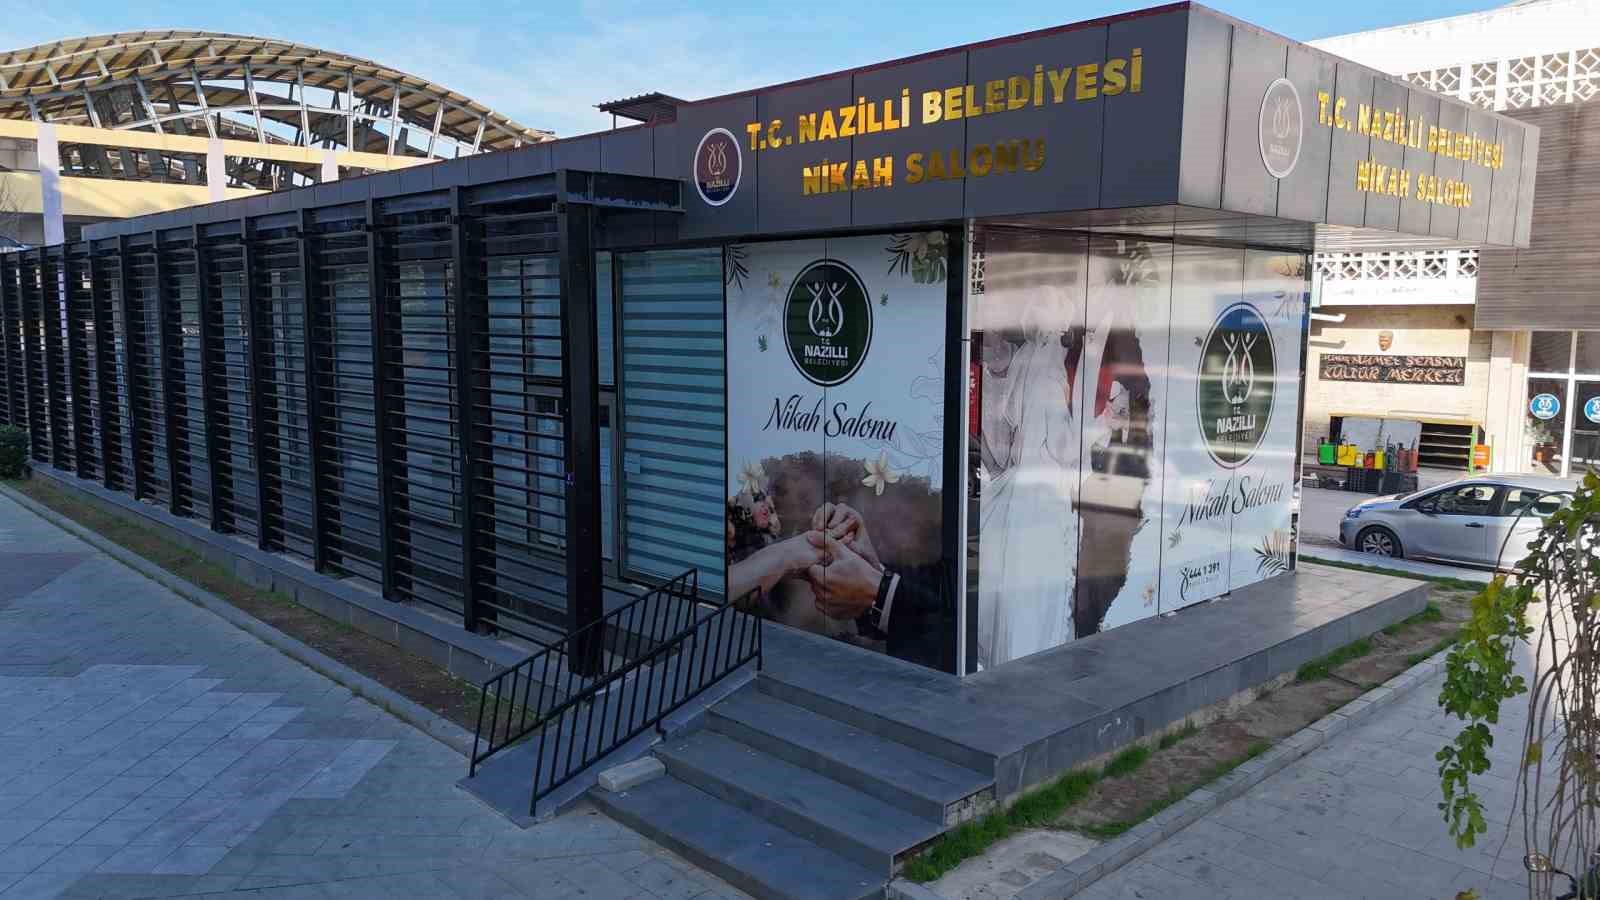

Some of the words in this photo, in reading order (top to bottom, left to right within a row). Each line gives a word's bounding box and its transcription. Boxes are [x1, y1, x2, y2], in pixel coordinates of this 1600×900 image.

[746, 120, 792, 150] T.C.
[799, 88, 910, 144] NAZİLLİ
[922, 47, 1143, 125] BELEDİYESİ
[1317, 91, 1352, 131] T.C.
[1356, 104, 1423, 149] NAZİLLİ
[1428, 125, 1504, 170] BELEDİYESİ
[803, 154, 894, 195] NİKAH
[905, 136, 1046, 184] SALONU
[1356, 157, 1409, 199] NİKAH
[1416, 173, 1472, 208] SALONU
[762, 394, 824, 432] Nikah
[824, 401, 897, 441] Salonu
[1176, 478, 1231, 530] Nikah
[1232, 472, 1284, 514] Salonu
